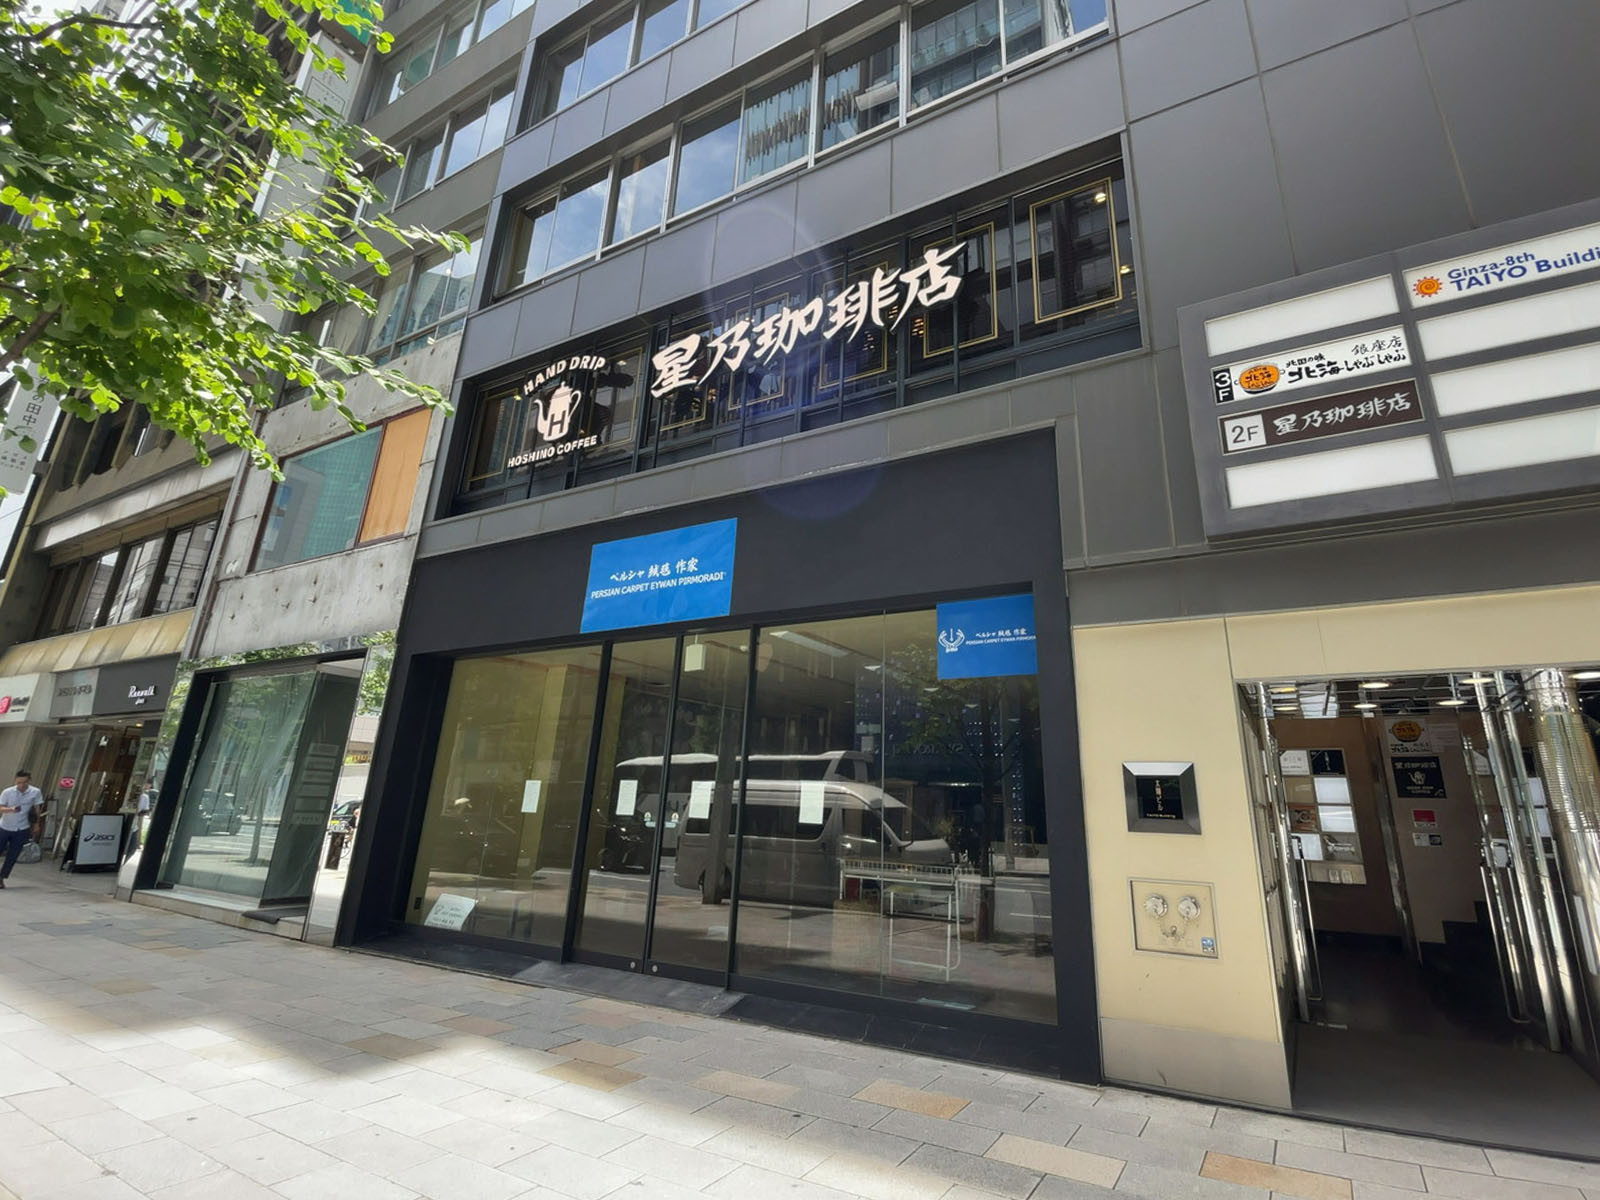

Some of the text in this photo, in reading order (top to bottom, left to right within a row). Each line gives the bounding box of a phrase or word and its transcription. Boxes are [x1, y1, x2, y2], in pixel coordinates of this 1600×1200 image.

[1448, 252, 1535, 279] Ginza-8th
[1450, 265, 1527, 291] TAIYO
[650, 241, 967, 398] 星乃珈琲店
[1352, 335, 1402, 356] 銀座店
[523, 355, 606, 395] HAND DRIP
[1272, 391, 1411, 436] 星乃珈琲店
[1231, 425, 1259, 444] 2F
[507, 434, 598, 468] HOSHINO COFFEE
[675, 556, 699, 574] 作家
[590, 571, 724, 600] PERSIAN CARPET EYWAN PIRMORADI
